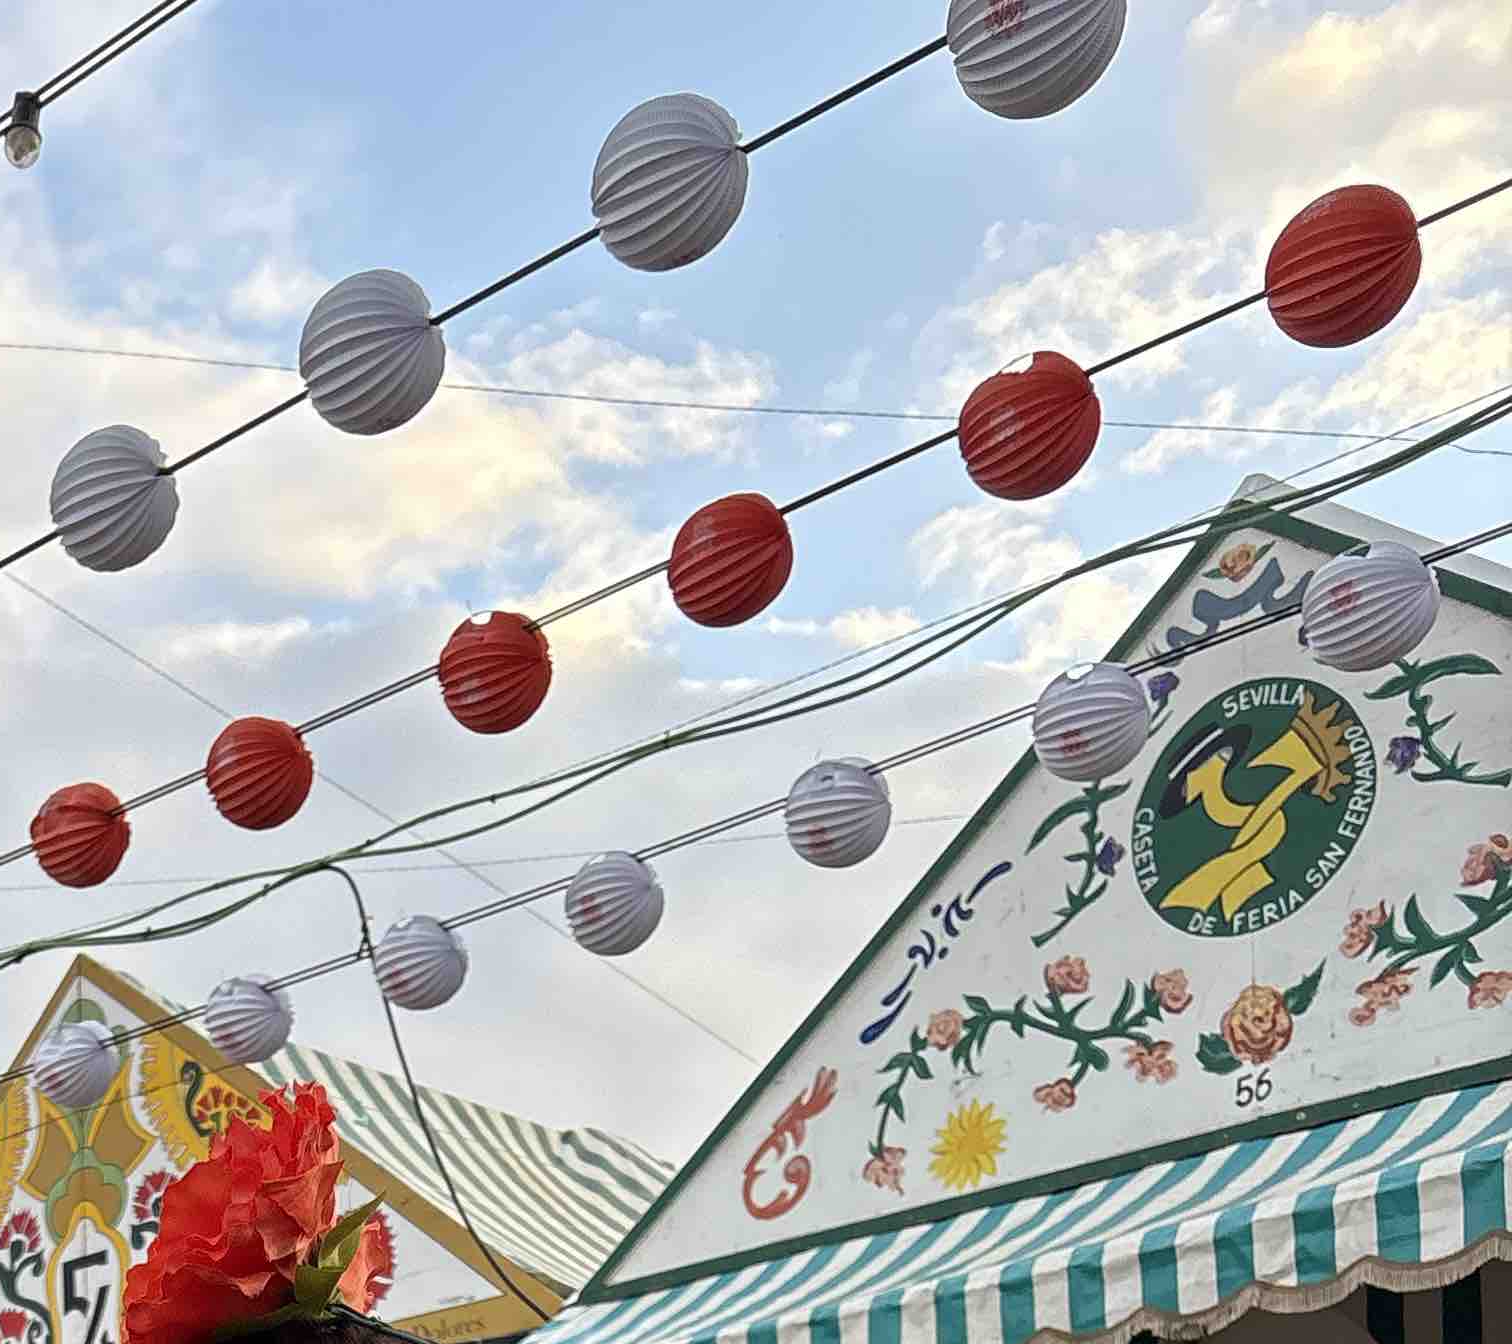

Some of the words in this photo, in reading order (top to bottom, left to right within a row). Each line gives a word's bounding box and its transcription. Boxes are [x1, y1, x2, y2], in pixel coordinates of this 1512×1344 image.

[1222, 683, 1305, 718] SEVILLA
[1132, 807, 1160, 893] CASETA
[1188, 912, 1217, 935] DE
[1233, 889, 1304, 935] FERIA
[1306, 841, 1347, 889] SAN
[1338, 725, 1376, 839] FERNANDO
[1235, 1067, 1273, 1107] 56
